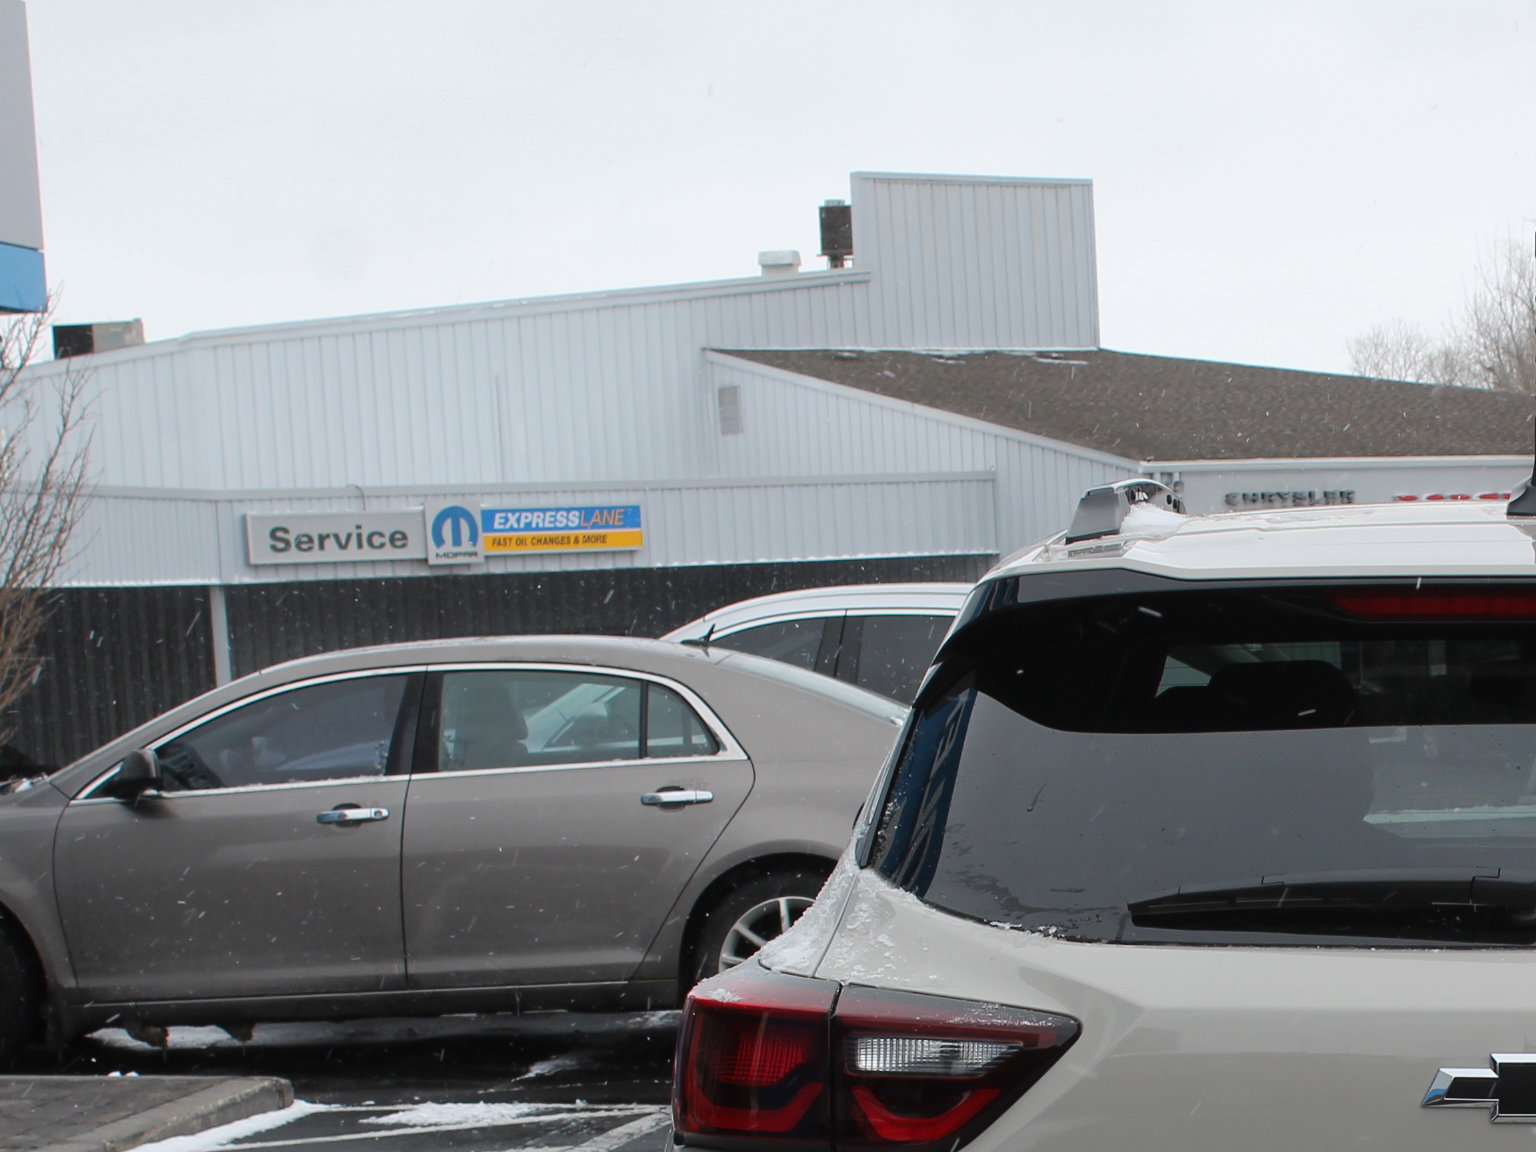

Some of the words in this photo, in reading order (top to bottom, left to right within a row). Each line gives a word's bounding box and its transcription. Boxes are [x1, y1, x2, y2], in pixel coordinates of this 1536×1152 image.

[268, 524, 408, 553] Service
[492, 537, 512, 548] FAST
[515, 537, 528, 547] OIL
[531, 536, 571, 546] CHANGES
[573, 535, 580, 545] &
[582, 534, 608, 545] MORE
[435, 551, 478, 560] MOPAR
